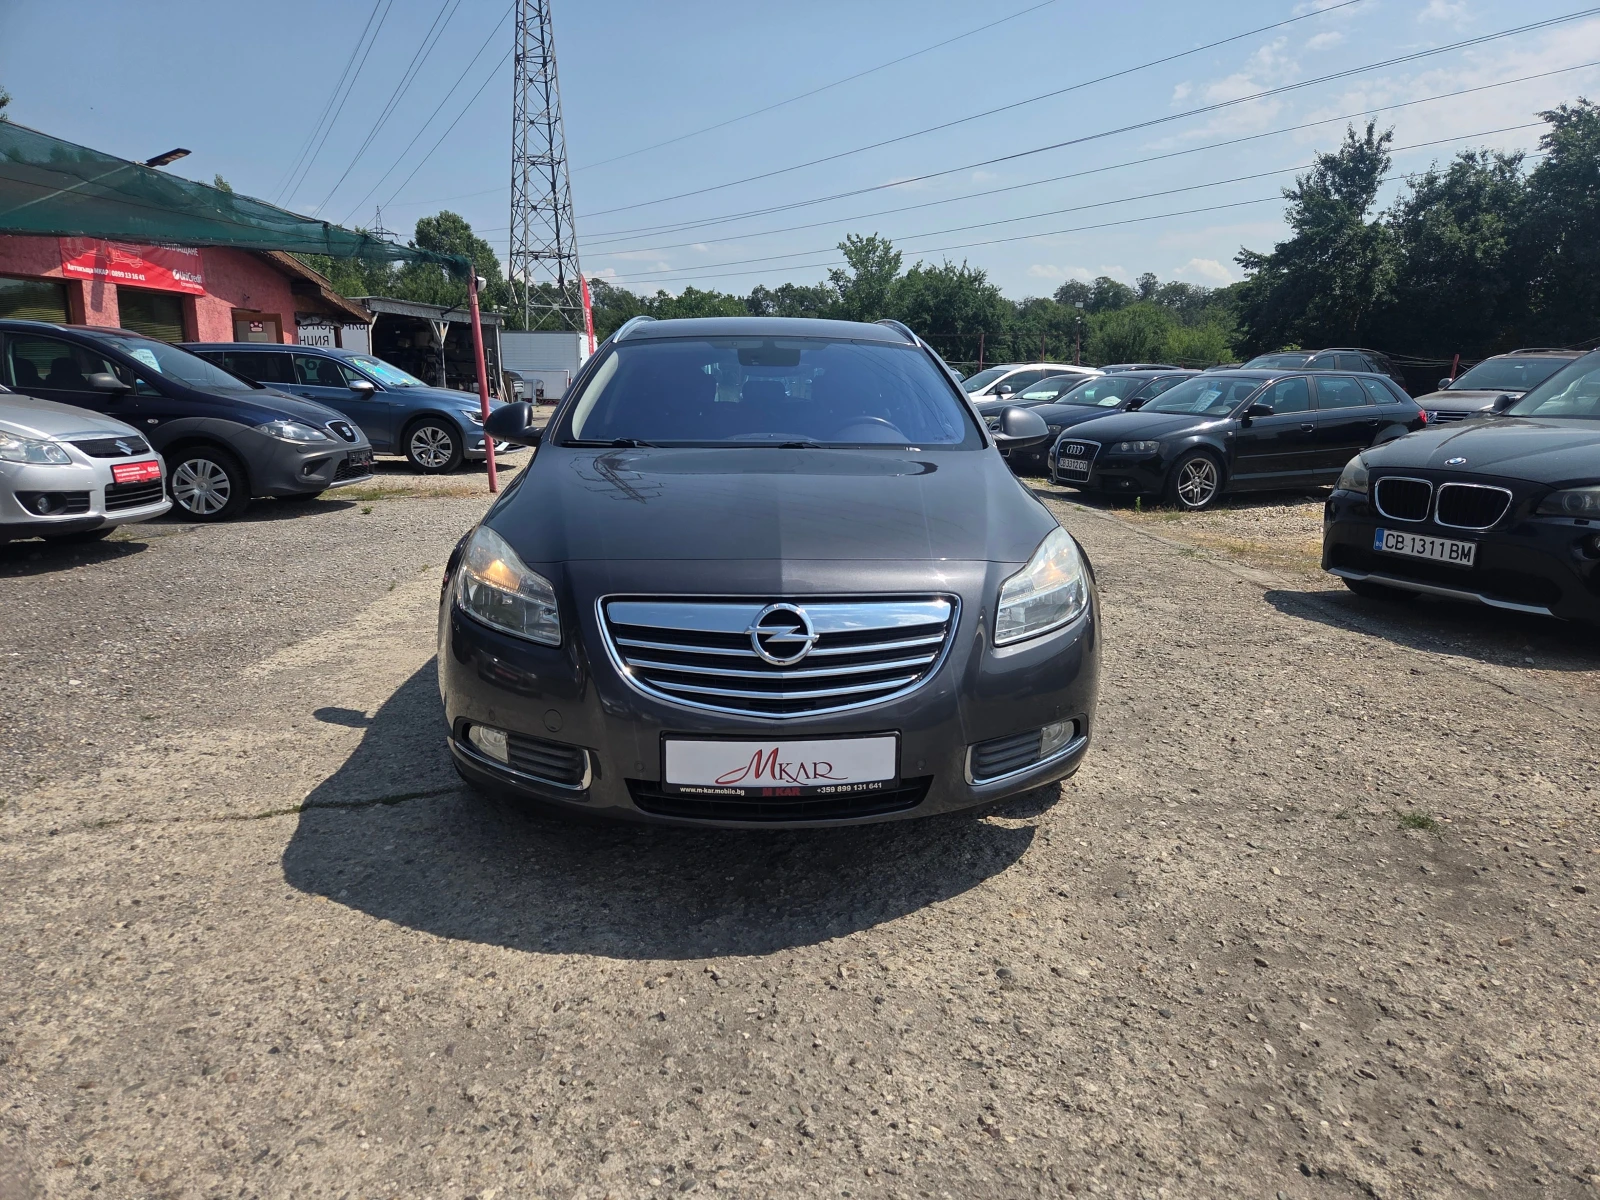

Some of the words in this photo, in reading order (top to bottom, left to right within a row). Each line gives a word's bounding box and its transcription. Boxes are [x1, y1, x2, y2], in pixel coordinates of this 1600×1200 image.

[111, 270, 124, 278] 0899
[125, 271, 132, 279] 13
[179, 269, 202, 284] UniCredit
[680, 787, 745, 796] www.m-kar.mobile.bg
[763, 788, 773, 796] M
[776, 787, 801, 796] KAR
